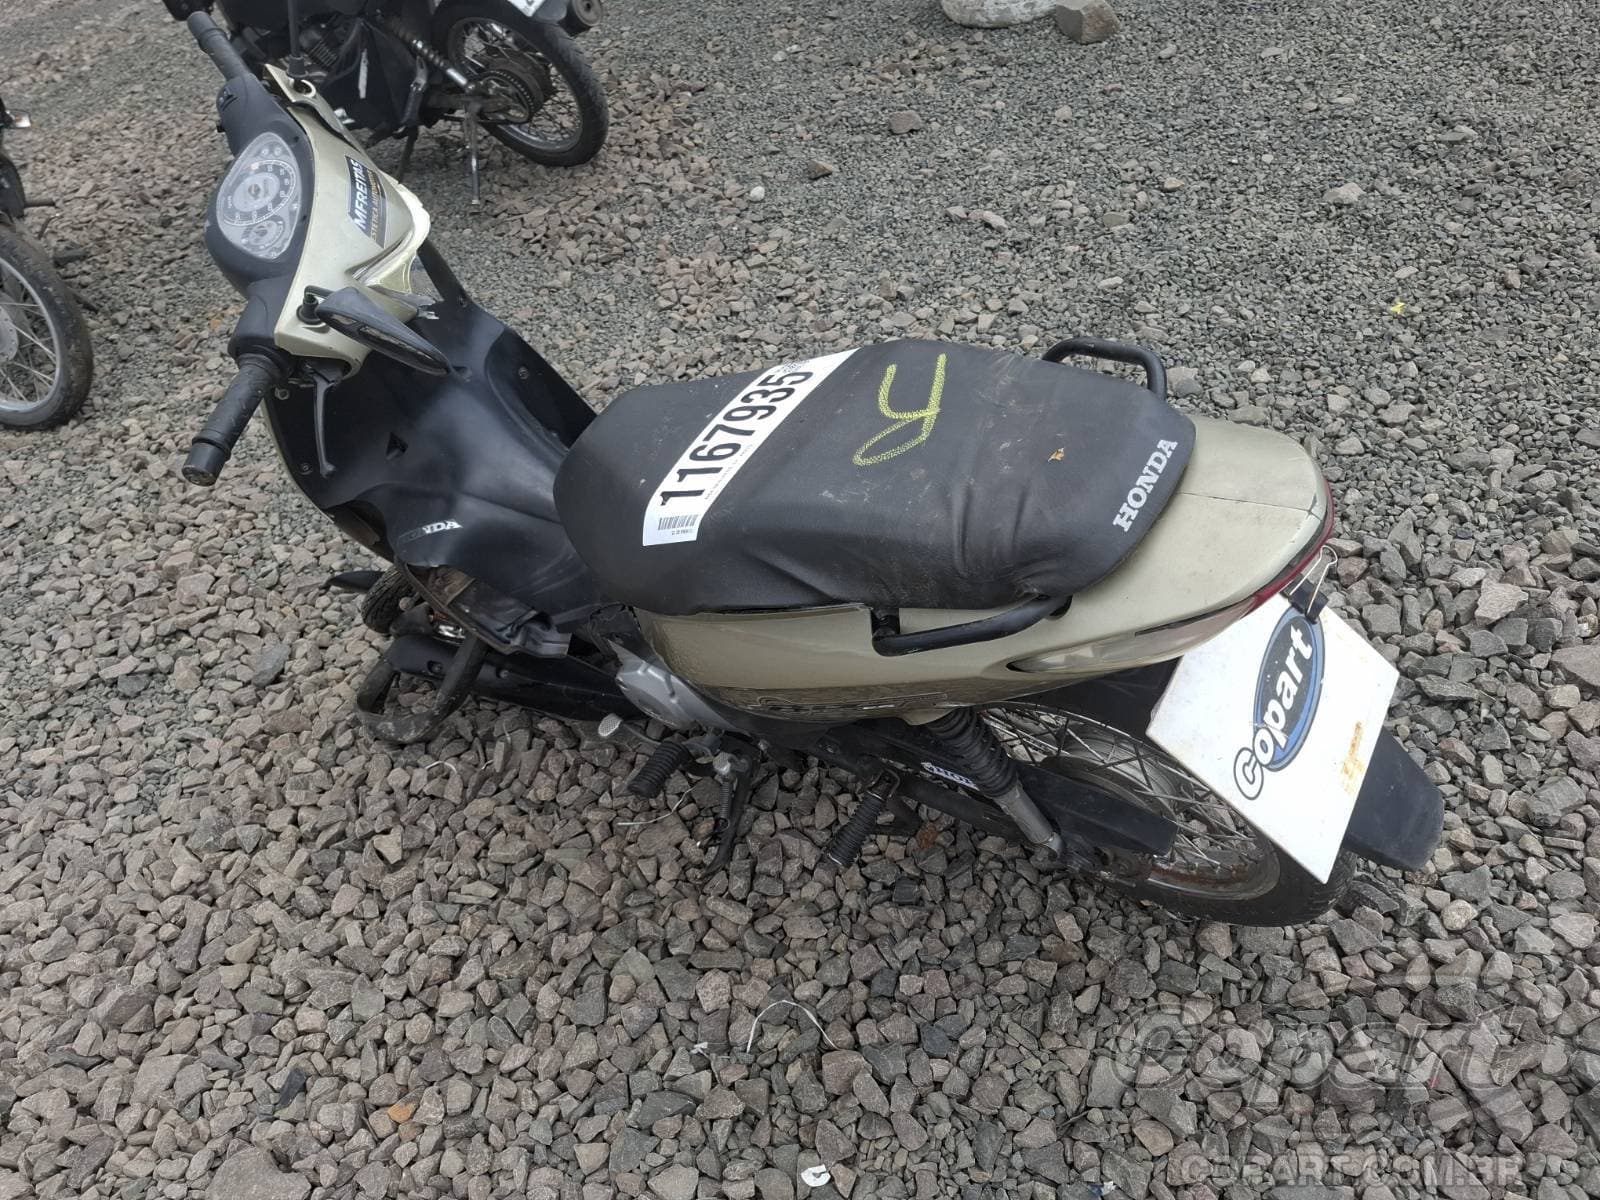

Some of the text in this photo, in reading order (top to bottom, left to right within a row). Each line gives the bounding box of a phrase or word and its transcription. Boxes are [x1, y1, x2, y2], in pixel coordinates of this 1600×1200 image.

[351, 159, 368, 230] MFREITAS
[660, 371, 814, 506] 1167935
[1112, 439, 1178, 532] HONDA
[1233, 624, 1313, 801] Copart
